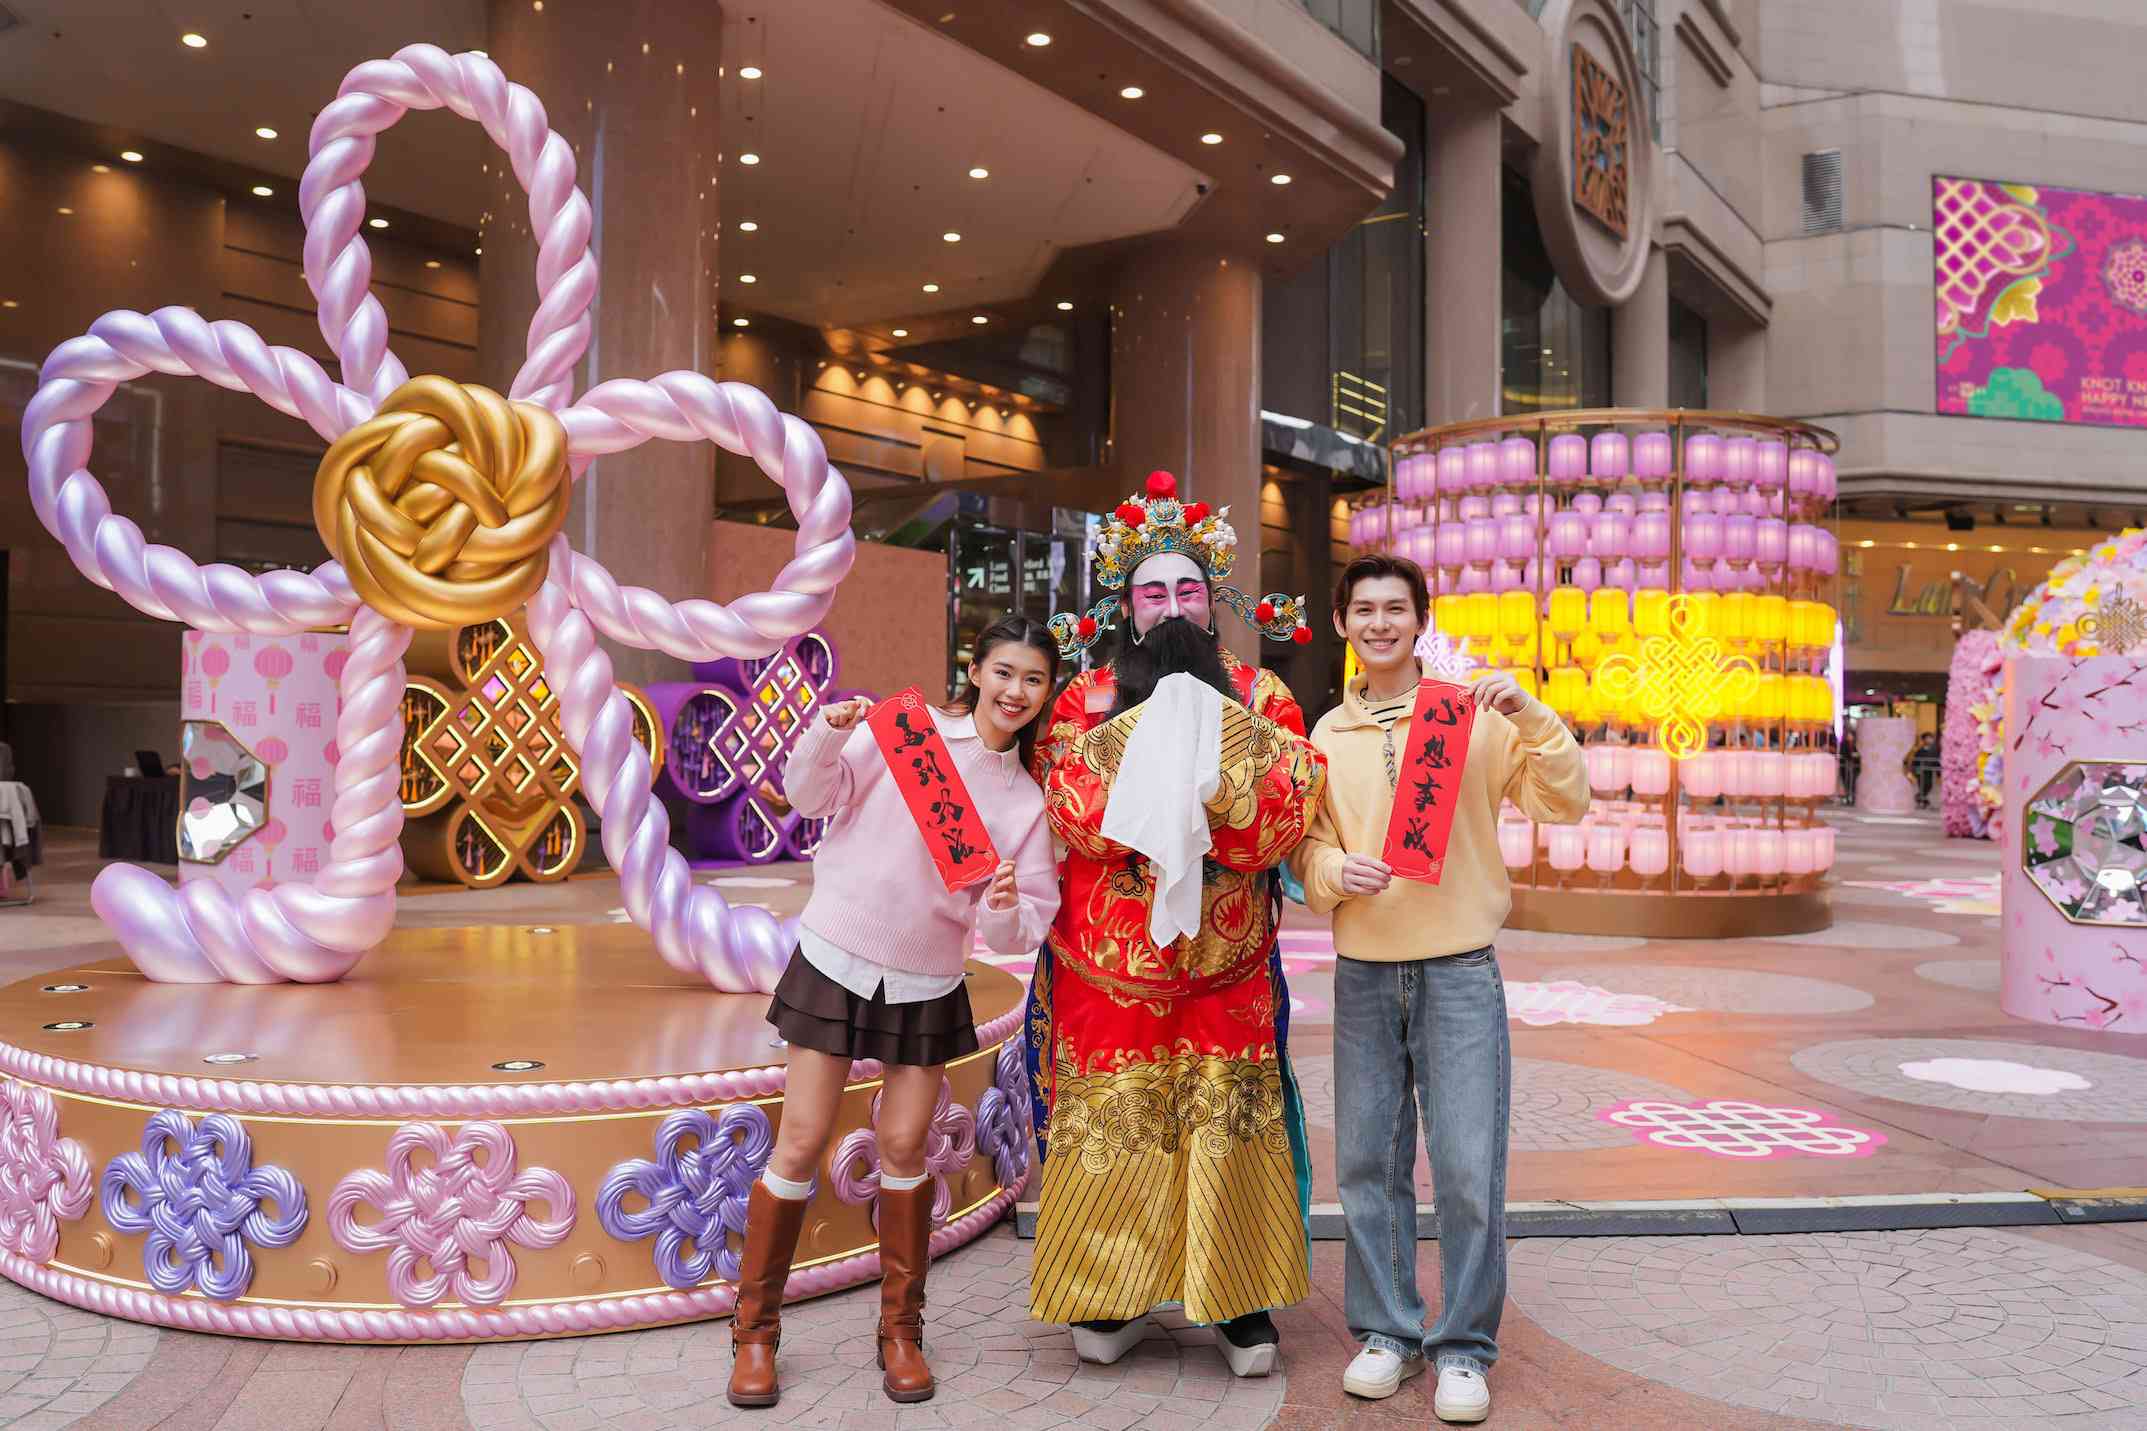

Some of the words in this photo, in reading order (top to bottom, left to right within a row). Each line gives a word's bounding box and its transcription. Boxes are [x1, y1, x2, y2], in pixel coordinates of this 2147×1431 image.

[2080, 391, 2128, 407] HAPPY
[232, 701, 257, 727] 福
[295, 702, 321, 728] 福
[894, 712, 988, 865] 馬到功成
[1403, 697, 1466, 860] 心想事成
[292, 778, 321, 808] 福
[292, 847, 320, 873] 福
